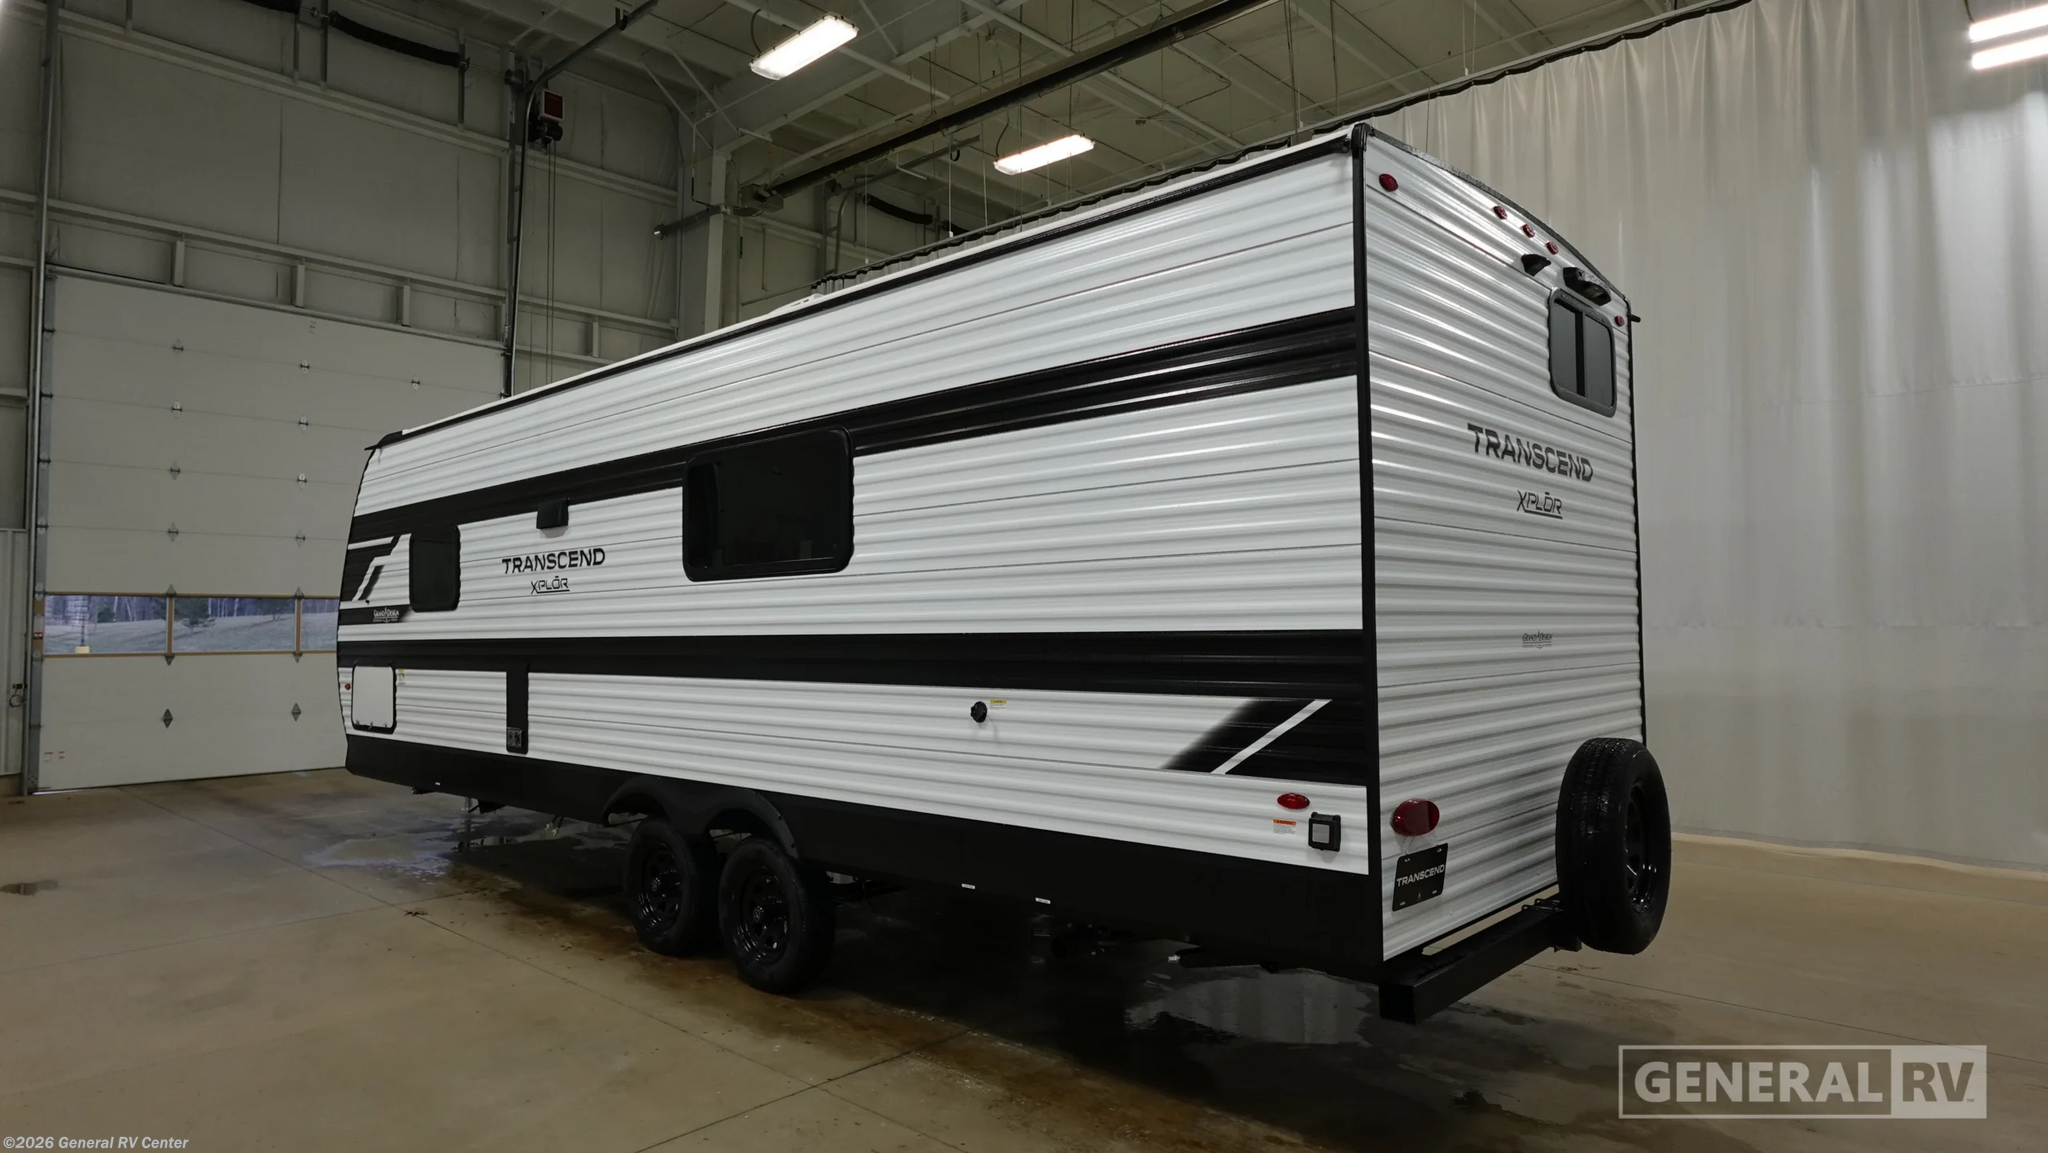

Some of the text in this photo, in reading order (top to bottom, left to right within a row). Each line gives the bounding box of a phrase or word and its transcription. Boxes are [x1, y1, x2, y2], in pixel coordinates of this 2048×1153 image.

[1467, 422, 1593, 482] TRANSCEND
[502, 547, 605, 574] TRANSCEND
[1397, 864, 1445, 887] TRANSCEND
